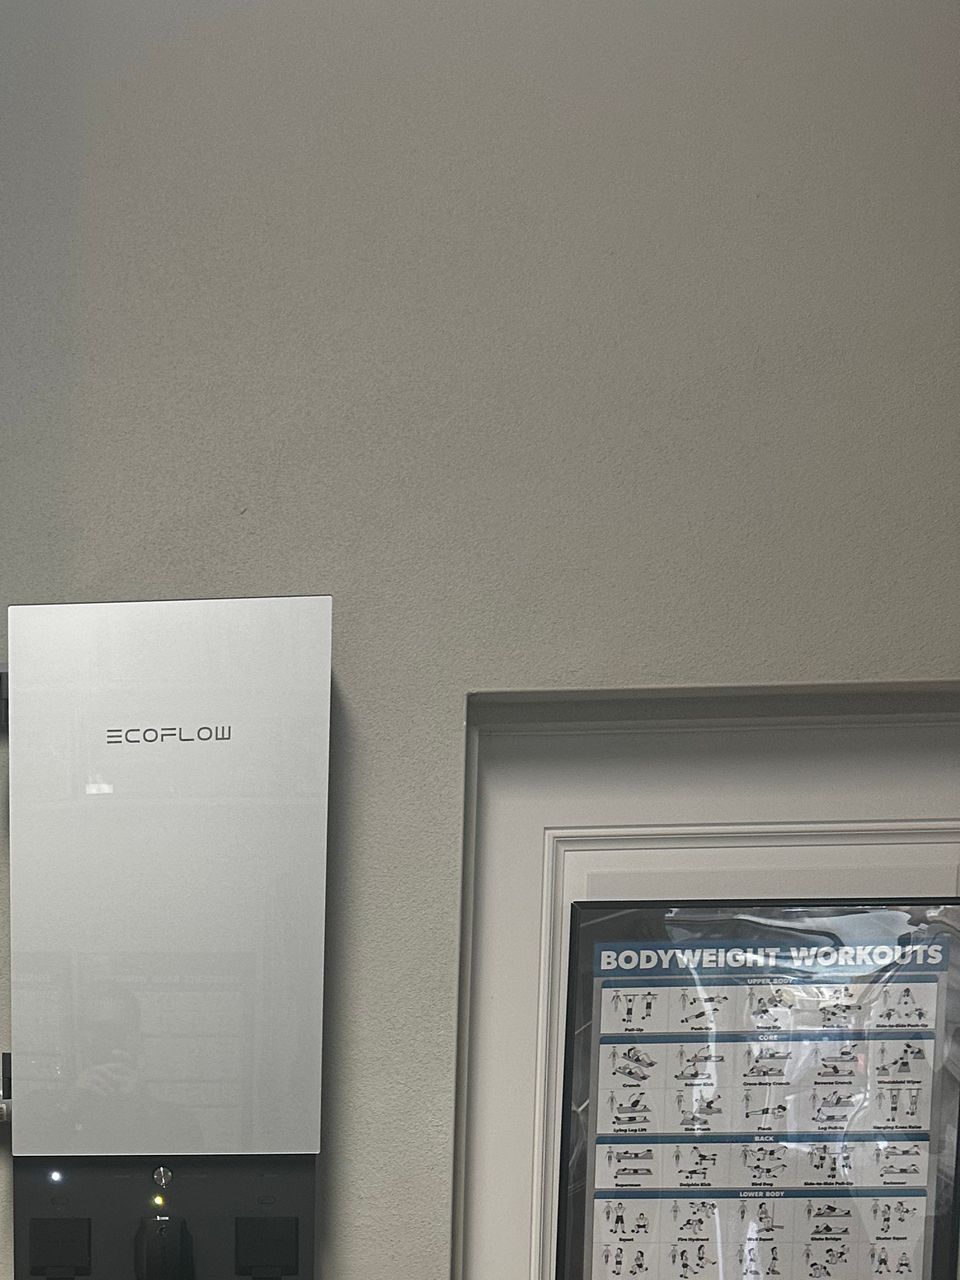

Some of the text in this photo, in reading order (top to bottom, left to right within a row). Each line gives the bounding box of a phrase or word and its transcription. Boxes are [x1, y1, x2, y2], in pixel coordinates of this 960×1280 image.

[106, 726, 231, 744] ECOFLOW
[600, 944, 943, 970] BODYWEIGHT WORKOUTS
